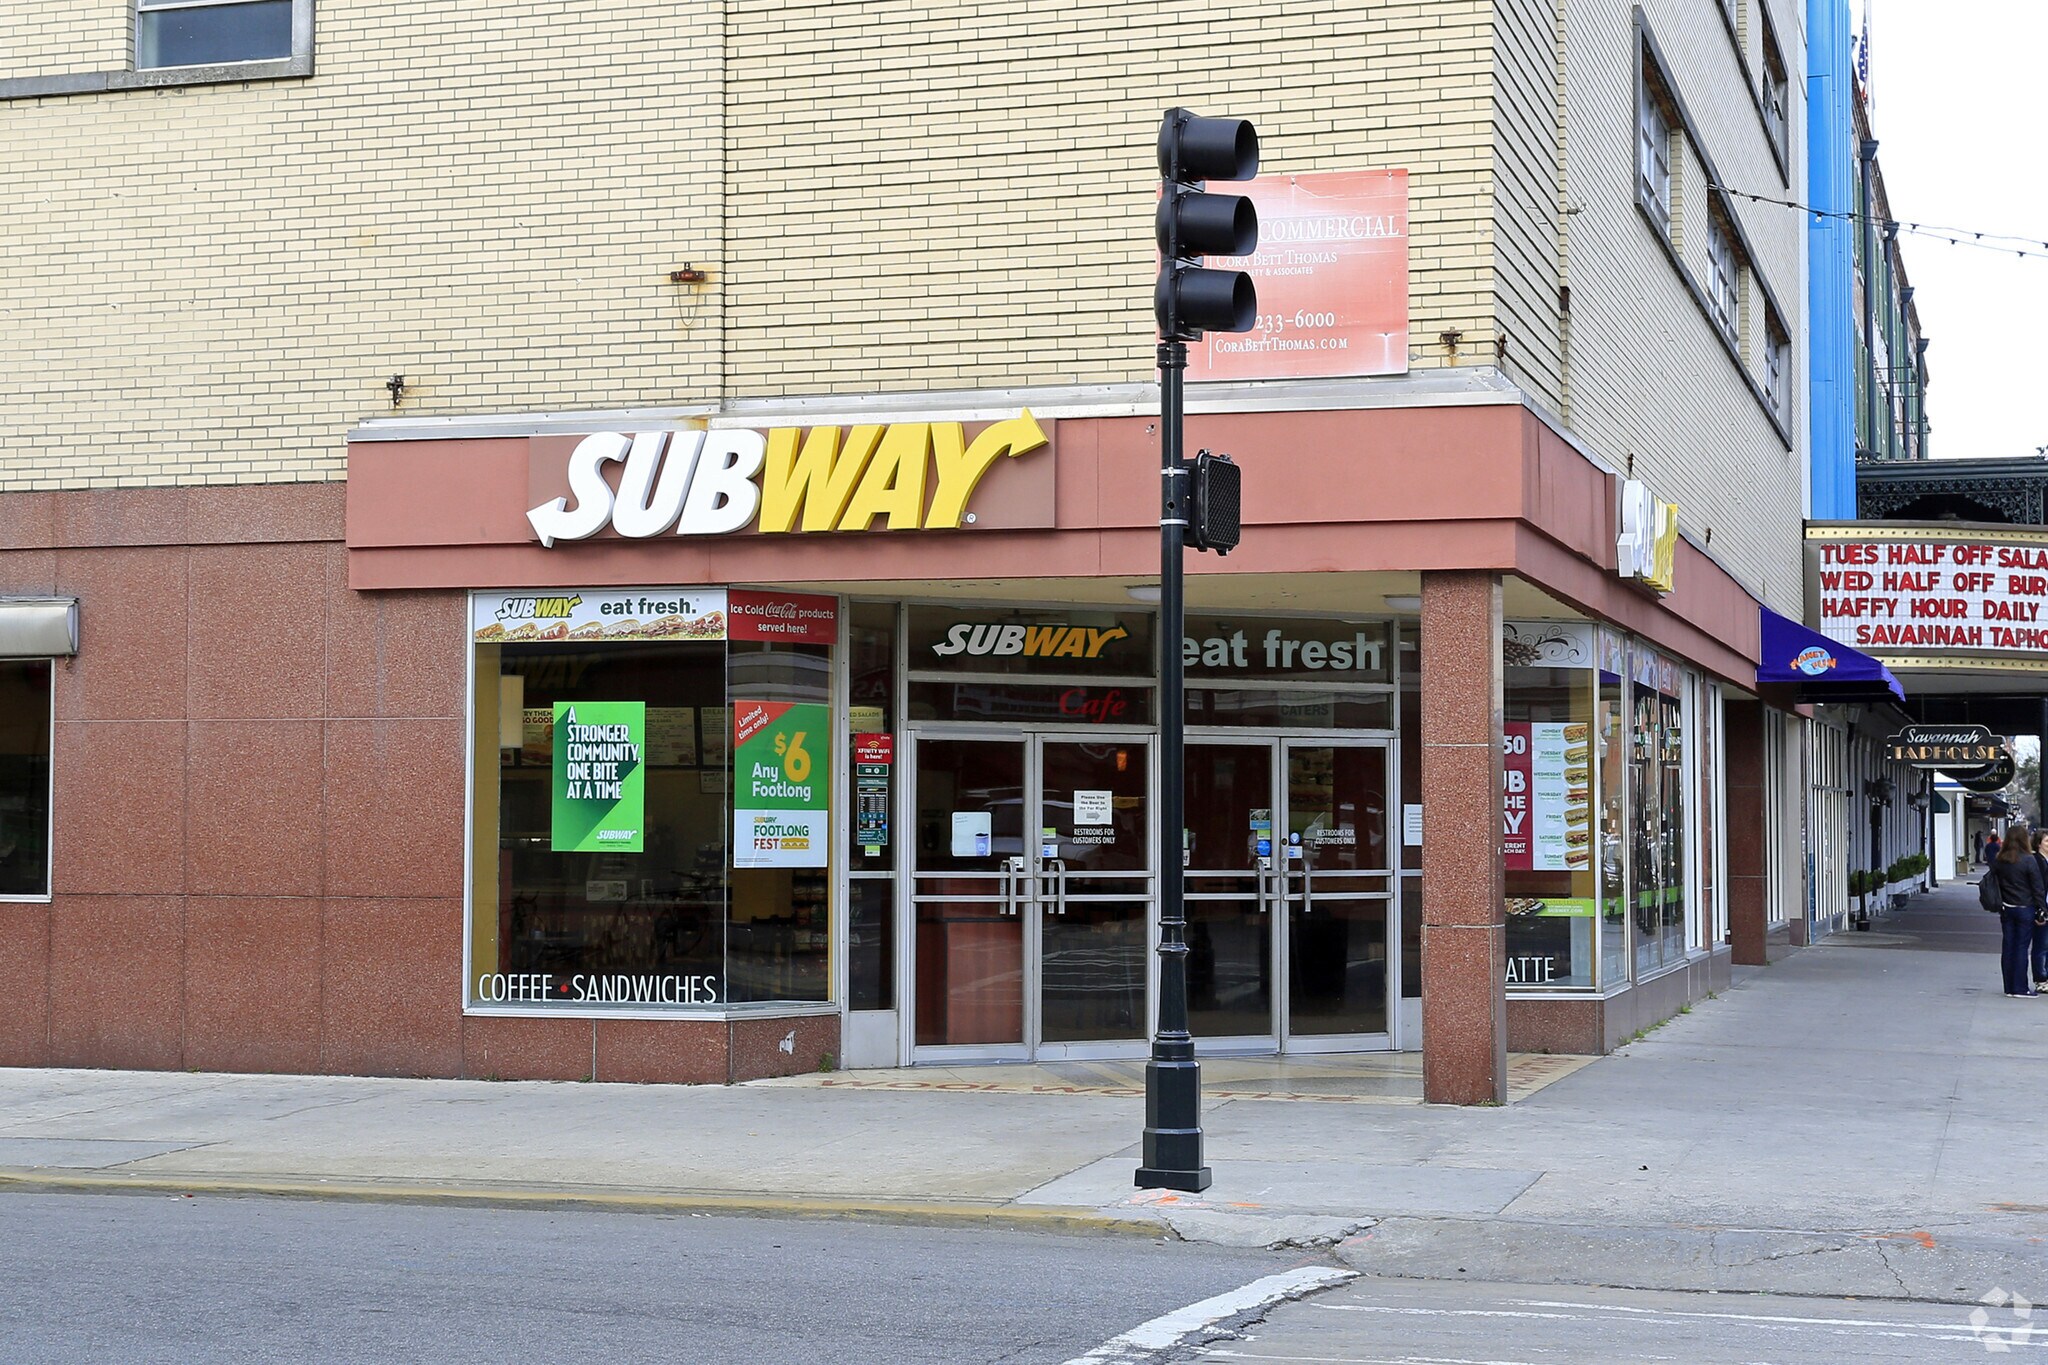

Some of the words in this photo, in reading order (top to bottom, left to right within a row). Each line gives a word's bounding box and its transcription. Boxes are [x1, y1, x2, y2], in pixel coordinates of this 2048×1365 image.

[1258, 216, 1400, 241] COMMERCIAL
[1216, 255, 1250, 268] CORA
[1253, 251, 1283, 266] BETT
[1285, 250, 1338, 264] THOMAS
[1265, 268, 1271, 276] &
[1273, 266, 1313, 275] ASSOCIATES
[526, 407, 1049, 548] SUBWAY
[1821, 545, 1879, 565] TUES
[1888, 545, 1946, 565] HALF
[1953, 546, 1994, 566] OFF
[1820, 571, 1874, 591] WED
[1883, 572, 1941, 591] HALF
[1953, 573, 1996, 593] OFF
[2009, 575, 2048, 596] BUR
[495, 594, 583, 621] SUBWAY
[600, 599, 633, 615] eat
[638, 598, 697, 614] fresh.
[731, 604, 743, 614] Ice
[745, 605, 764, 615] Cold
[799, 609, 834, 619] products
[1822, 598, 1898, 618] HAFFY
[1911, 598, 1968, 618] HOUR
[1983, 600, 2040, 622] DAILY
[758, 623, 785, 632] served
[787, 624, 808, 633] here!
[1857, 625, 1983, 646] SAVANNAH
[932, 624, 1128, 657] SUBWAY
[1184, 630, 1248, 667] eat
[1263, 630, 1381, 670] fresh
[1811, 658, 1837, 670] FUN
[567, 706, 577, 724] A
[1059, 688, 1127, 724] Cafe
[1281, 705, 1329, 716] CATERS
[738, 705, 762, 727] Limited
[567, 724, 630, 742] STRONGER
[738, 726, 753, 740] time
[753, 713, 769, 729] only!
[1907, 728, 1983, 743] Savannah
[567, 743, 641, 763] COMMUNITY,
[774, 731, 811, 782] $6
[1893, 746, 2000, 760] TAPHOUSE
[567, 762, 591, 780] ONE
[593, 762, 618, 780] BITE
[752, 762, 778, 782] Any
[567, 781, 582, 799] AT
[583, 781, 593, 799] A
[594, 781, 622, 799] TIME
[752, 781, 811, 802] Footlong
[596, 829, 637, 840] SUBWAY
[754, 825, 809, 837] FOOTLONG
[1074, 828, 1104, 836] RESTROOMS
[1104, 828, 1115, 836] FOR
[1316, 829, 1345, 837] RESTROOMS
[1344, 829, 1355, 837] FOR
[754, 838, 779, 850] FEST
[1315, 837, 1343, 845] CUSTOMERS
[1343, 837, 1356, 845] ONLY
[1505, 957, 1554, 982] ATTE
[479, 974, 553, 1002] COFFEE
[572, 975, 717, 1004] SANDWICHES
